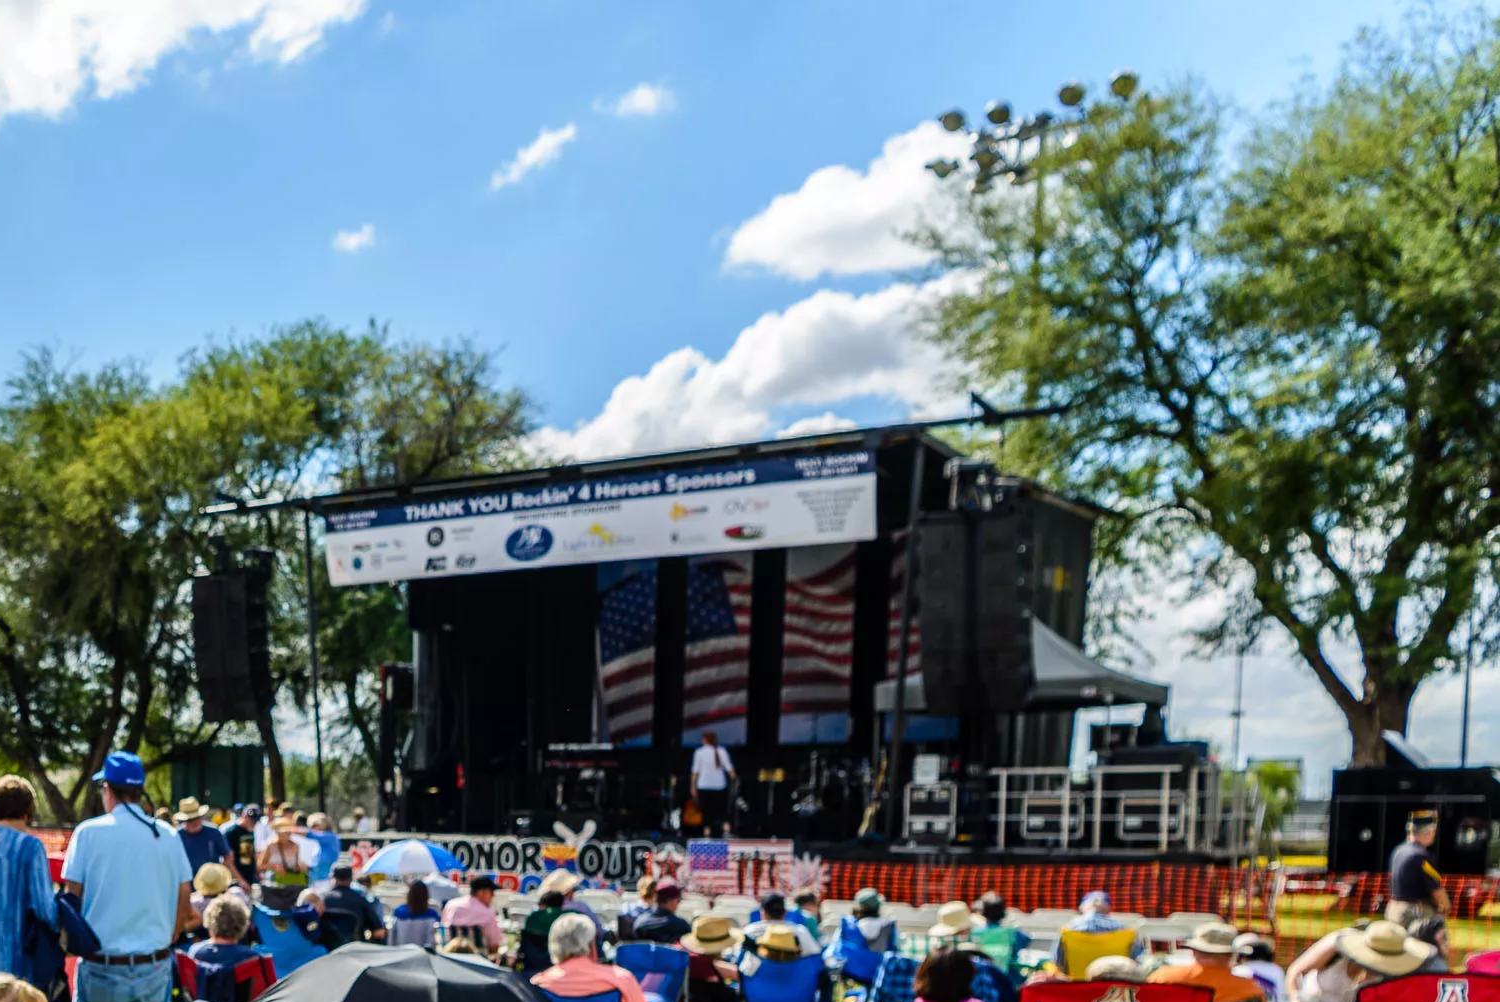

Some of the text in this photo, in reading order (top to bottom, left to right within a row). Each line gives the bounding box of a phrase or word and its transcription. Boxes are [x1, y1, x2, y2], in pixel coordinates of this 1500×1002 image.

[404, 468, 756, 521] THANK YOU Rockin' 4 Heroes Sponsors
[440, 840, 655, 879] ONOR OUR
